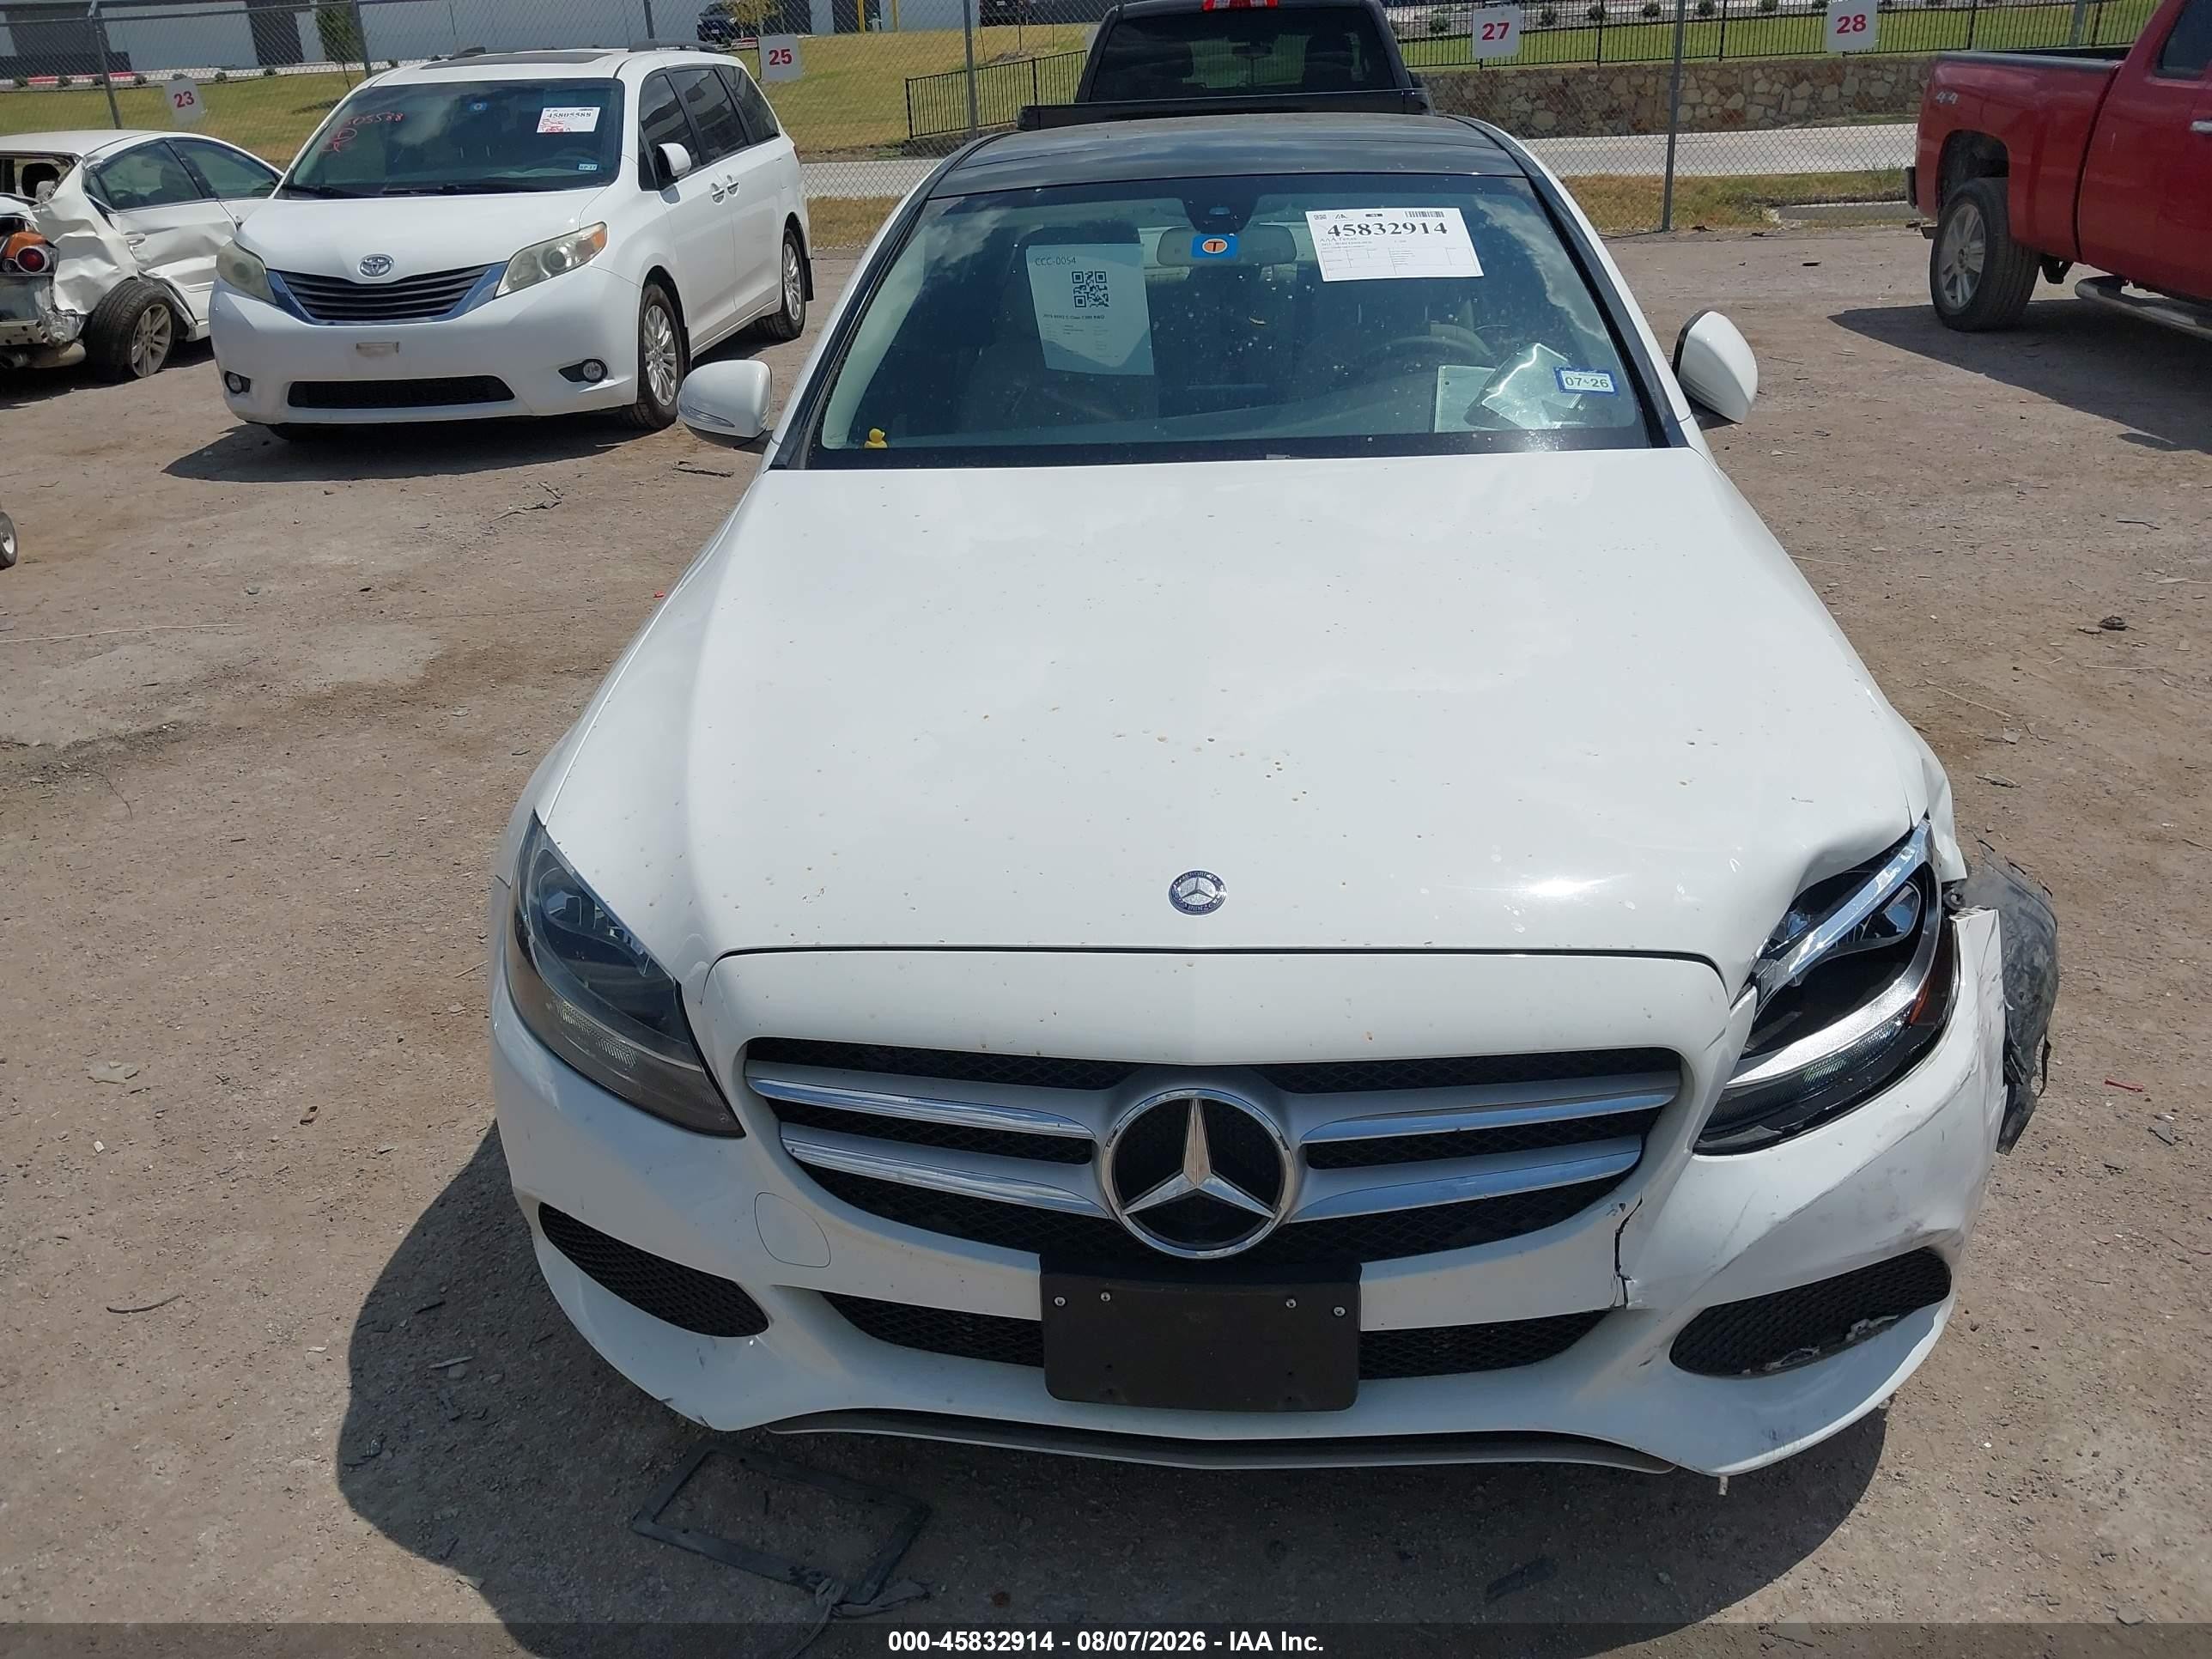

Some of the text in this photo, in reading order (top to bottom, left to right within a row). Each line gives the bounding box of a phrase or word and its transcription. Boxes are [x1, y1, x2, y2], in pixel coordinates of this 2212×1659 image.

[1482, 22, 1510, 40] 27
[1837, 14, 1866, 33] 28
[769, 48, 792, 65] 25
[173, 90, 194, 108] 23
[1328, 222, 1448, 236] 45832914
[1035, 257, 1076, 265] CCC-0054
[1565, 377, 1609, 388] 07 26
